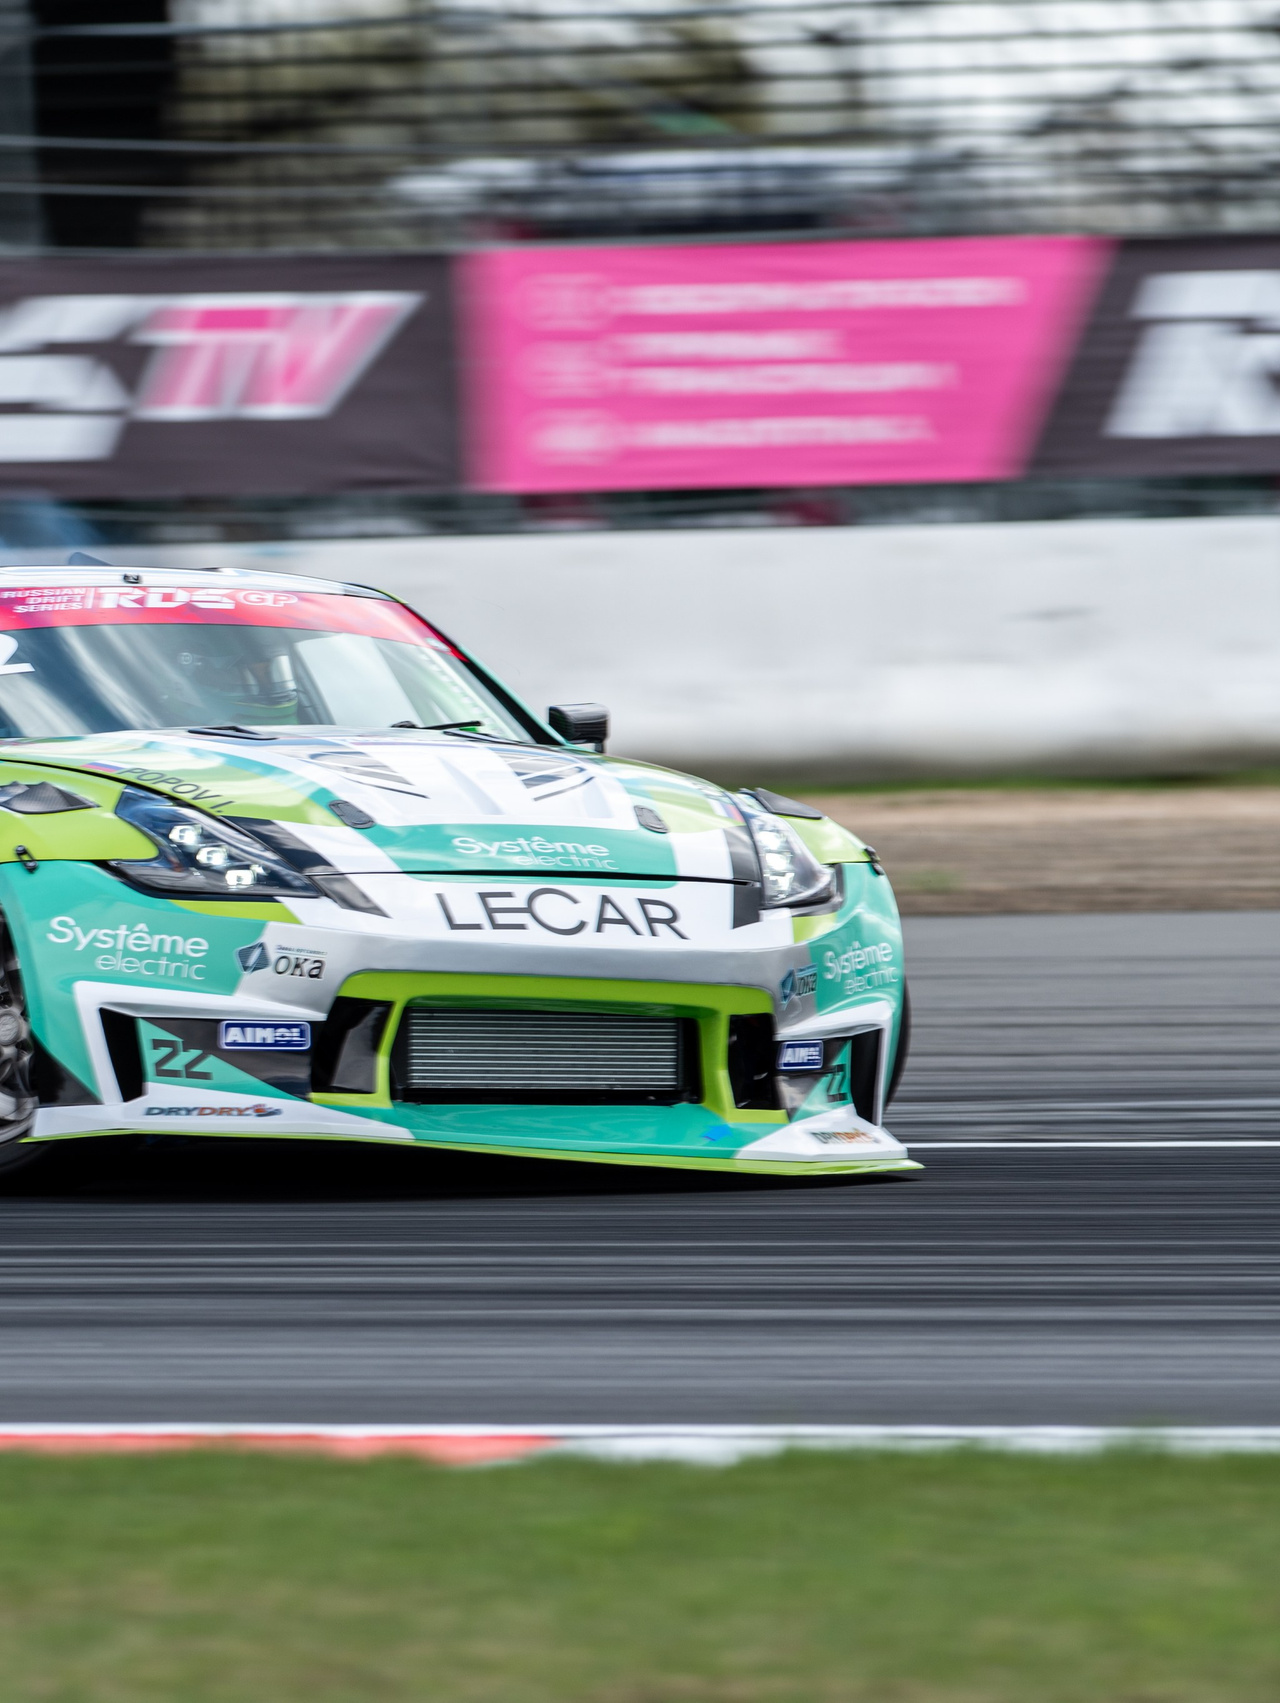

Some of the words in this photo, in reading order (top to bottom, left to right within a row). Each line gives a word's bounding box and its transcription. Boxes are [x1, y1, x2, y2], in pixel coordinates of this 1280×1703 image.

[0, 588, 87, 599] RUSSIAN
[25, 595, 84, 605] DRIFT
[98, 586, 236, 609] RDS
[237, 590, 298, 607] GP
[13, 602, 83, 613] SERIES
[116, 767, 223, 801] POPOV
[450, 835, 612, 858] Systême
[518, 849, 619, 870] electric
[435, 887, 690, 940] LECAR
[46, 915, 210, 959] Systême
[94, 950, 208, 980] electric
[225, 1025, 304, 1045] AIMOL
[152, 1038, 213, 1080] 22
